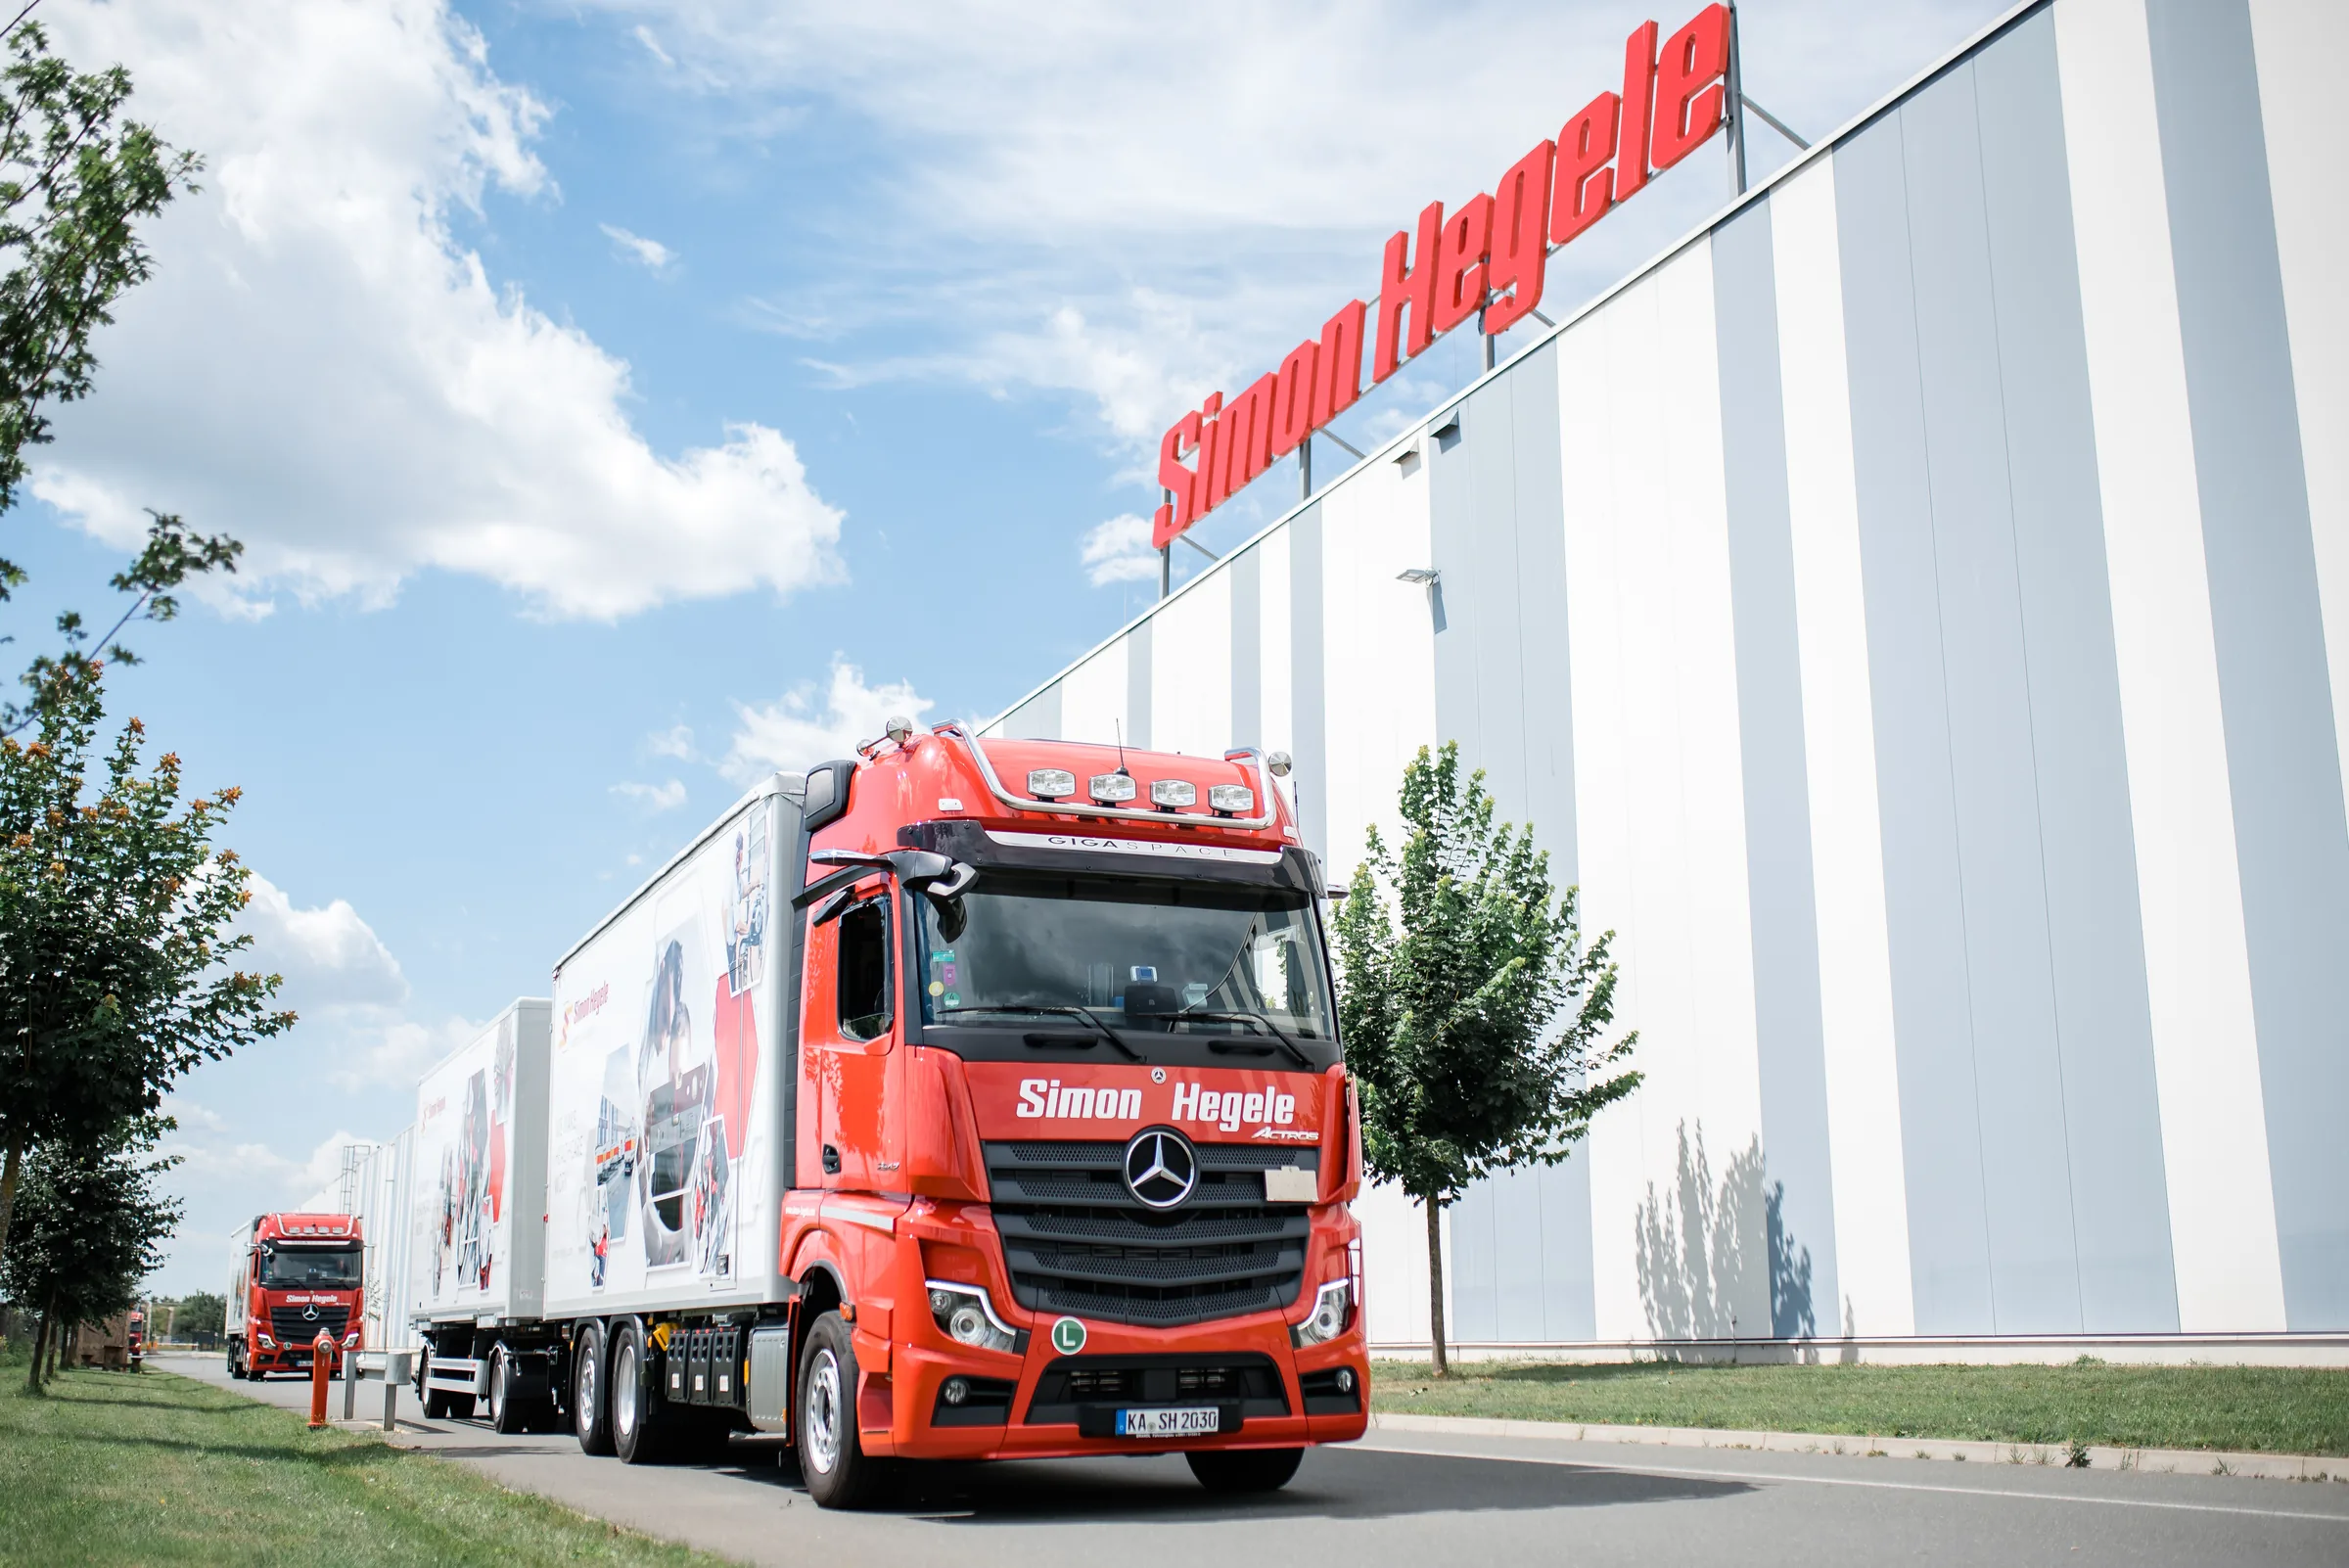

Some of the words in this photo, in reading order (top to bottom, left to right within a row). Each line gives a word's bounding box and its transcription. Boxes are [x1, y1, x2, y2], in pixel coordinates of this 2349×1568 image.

[1152, 299, 1366, 549] Simon
[1372, 2, 1730, 383] Hegele
[1016, 1079, 1142, 1120] Simon
[1171, 1082, 1295, 1132] Hegele
[1063, 1324, 1076, 1347] L
[1128, 1413, 1146, 1431] KA
[1159, 1412, 1177, 1430] SH
[1181, 1411, 1217, 1429] 2030
